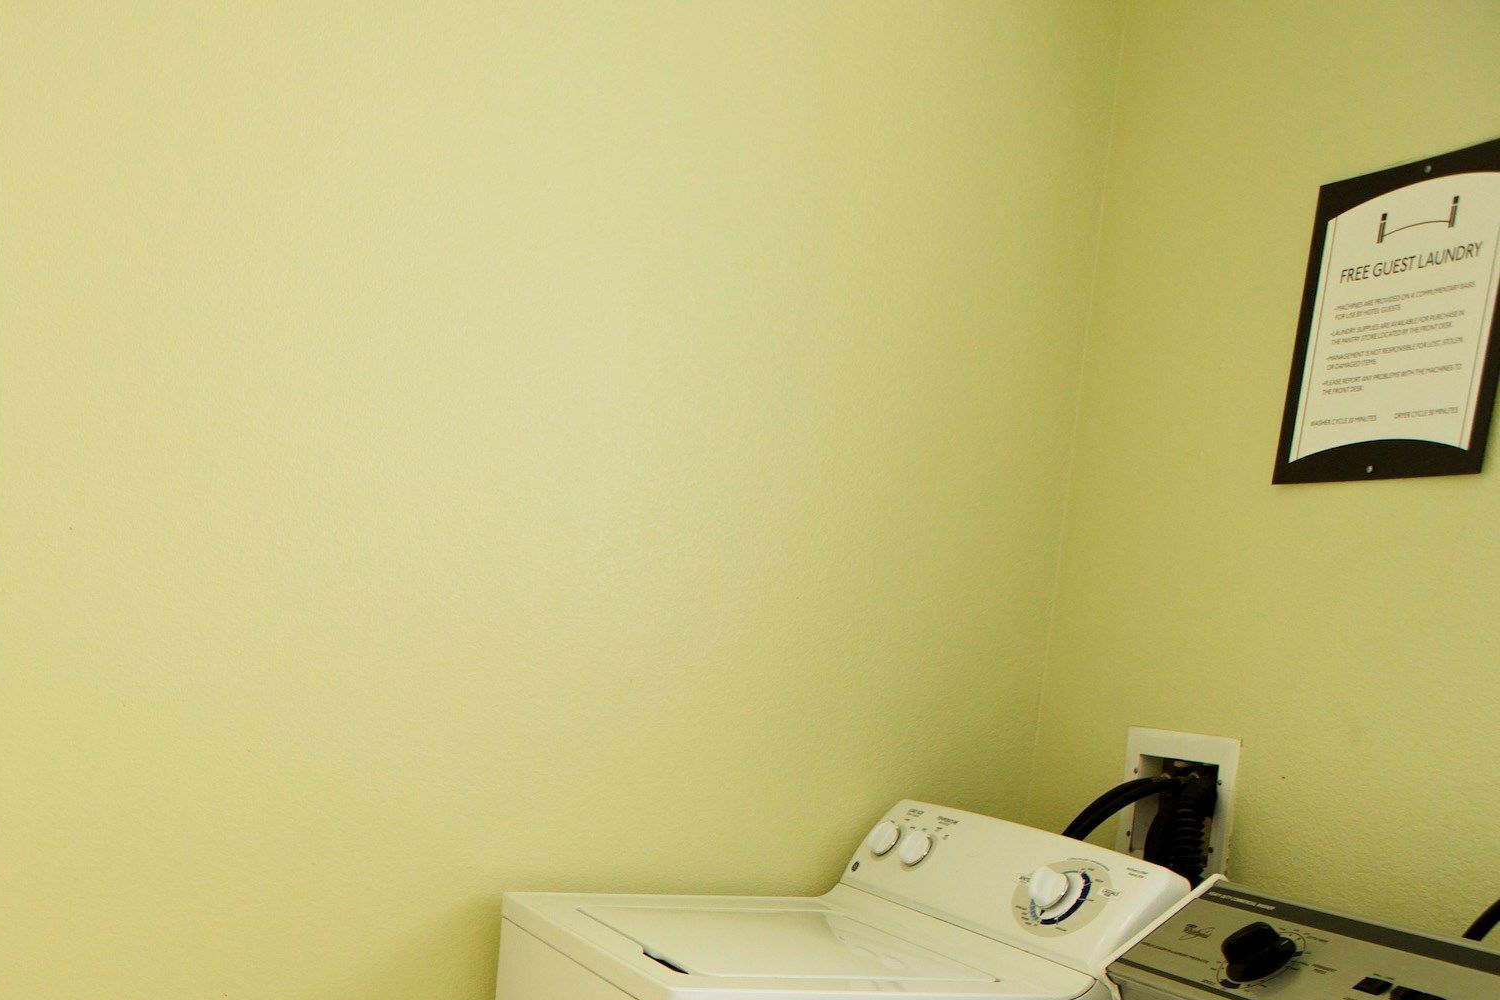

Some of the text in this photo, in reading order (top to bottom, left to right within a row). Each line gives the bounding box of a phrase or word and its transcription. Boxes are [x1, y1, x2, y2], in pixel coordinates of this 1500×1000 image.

[1340, 241, 1483, 283] FREE GUEST LAUNDRY
